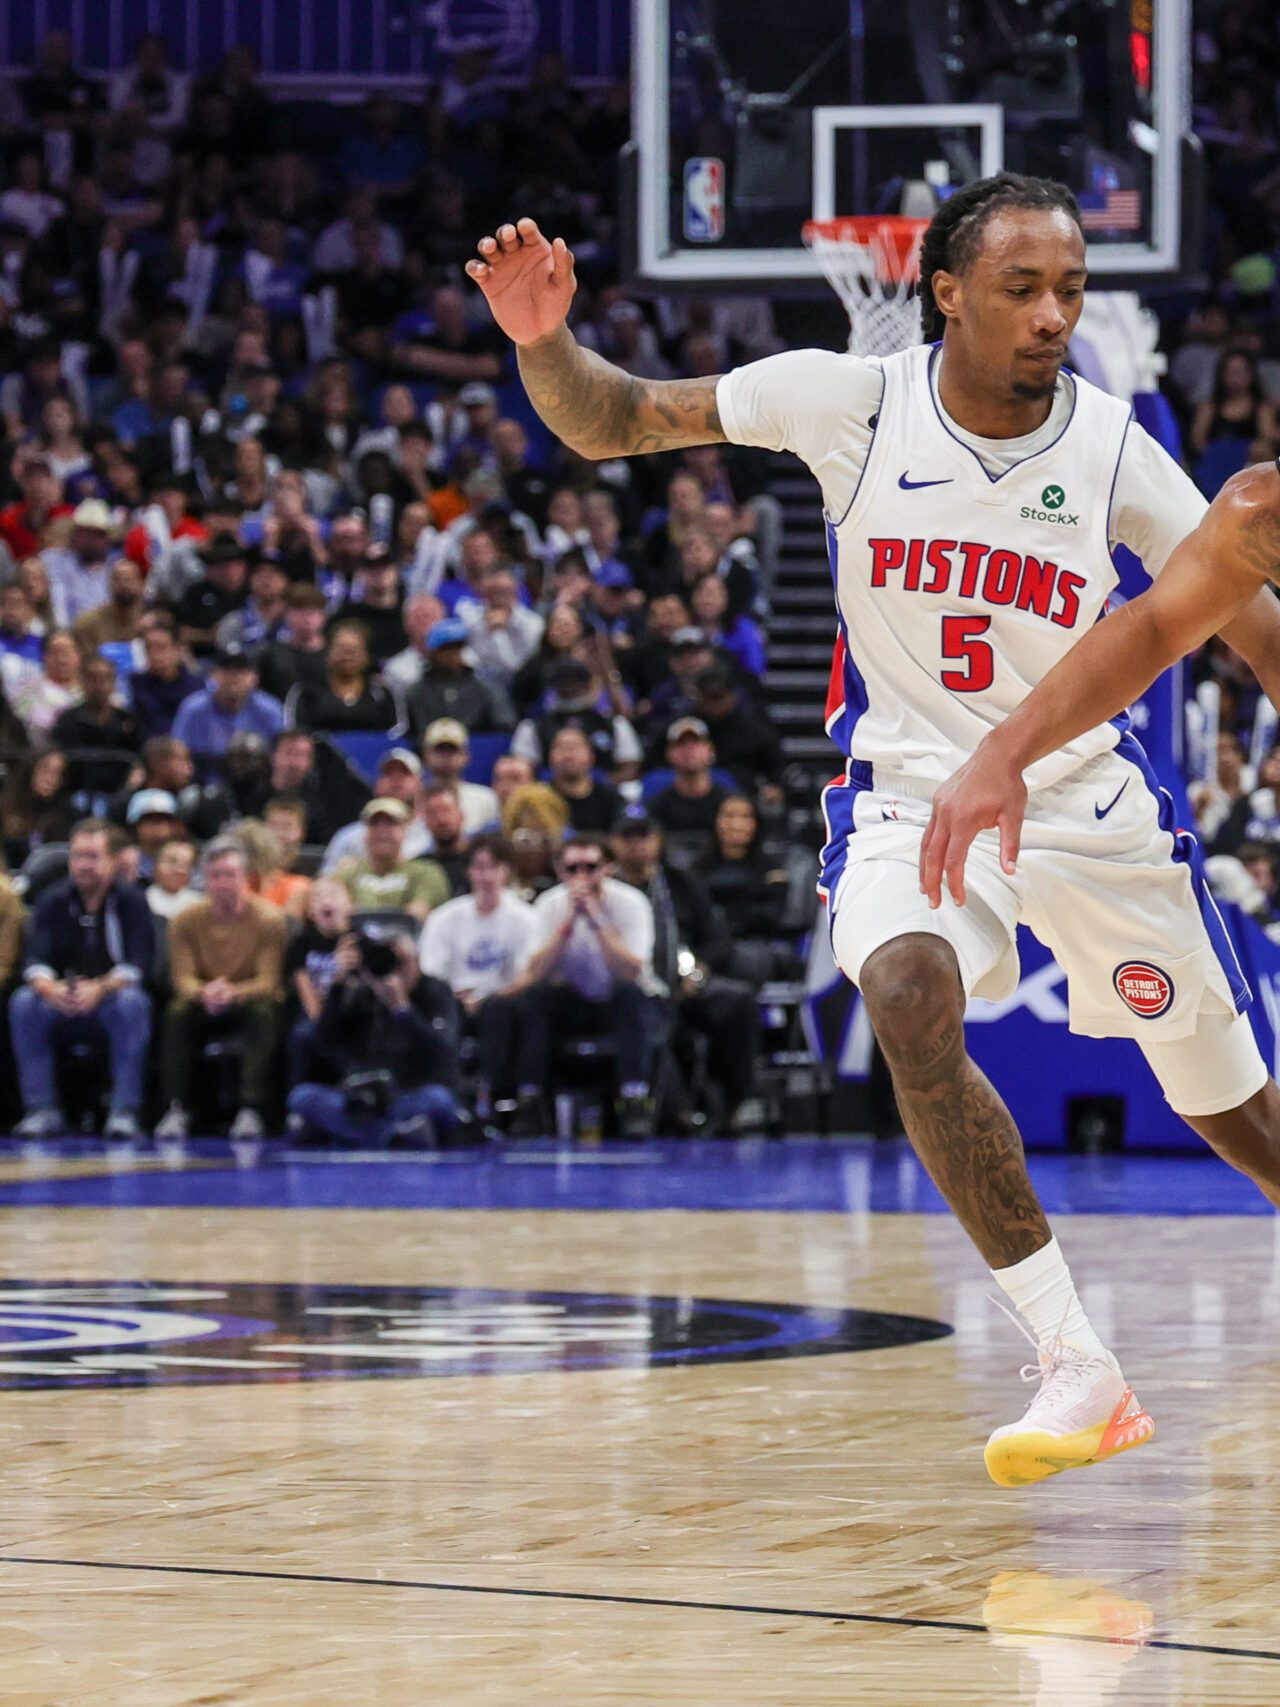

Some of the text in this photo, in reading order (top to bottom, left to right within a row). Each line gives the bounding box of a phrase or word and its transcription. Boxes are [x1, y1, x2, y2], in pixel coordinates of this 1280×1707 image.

[1020, 506, 1079, 526] StockX
[868, 538, 1086, 629] PISTONS
[941, 615, 994, 692] 5
[1122, 979, 1160, 990] DETROIT
[1124, 988, 1163, 1000] PISTONS
